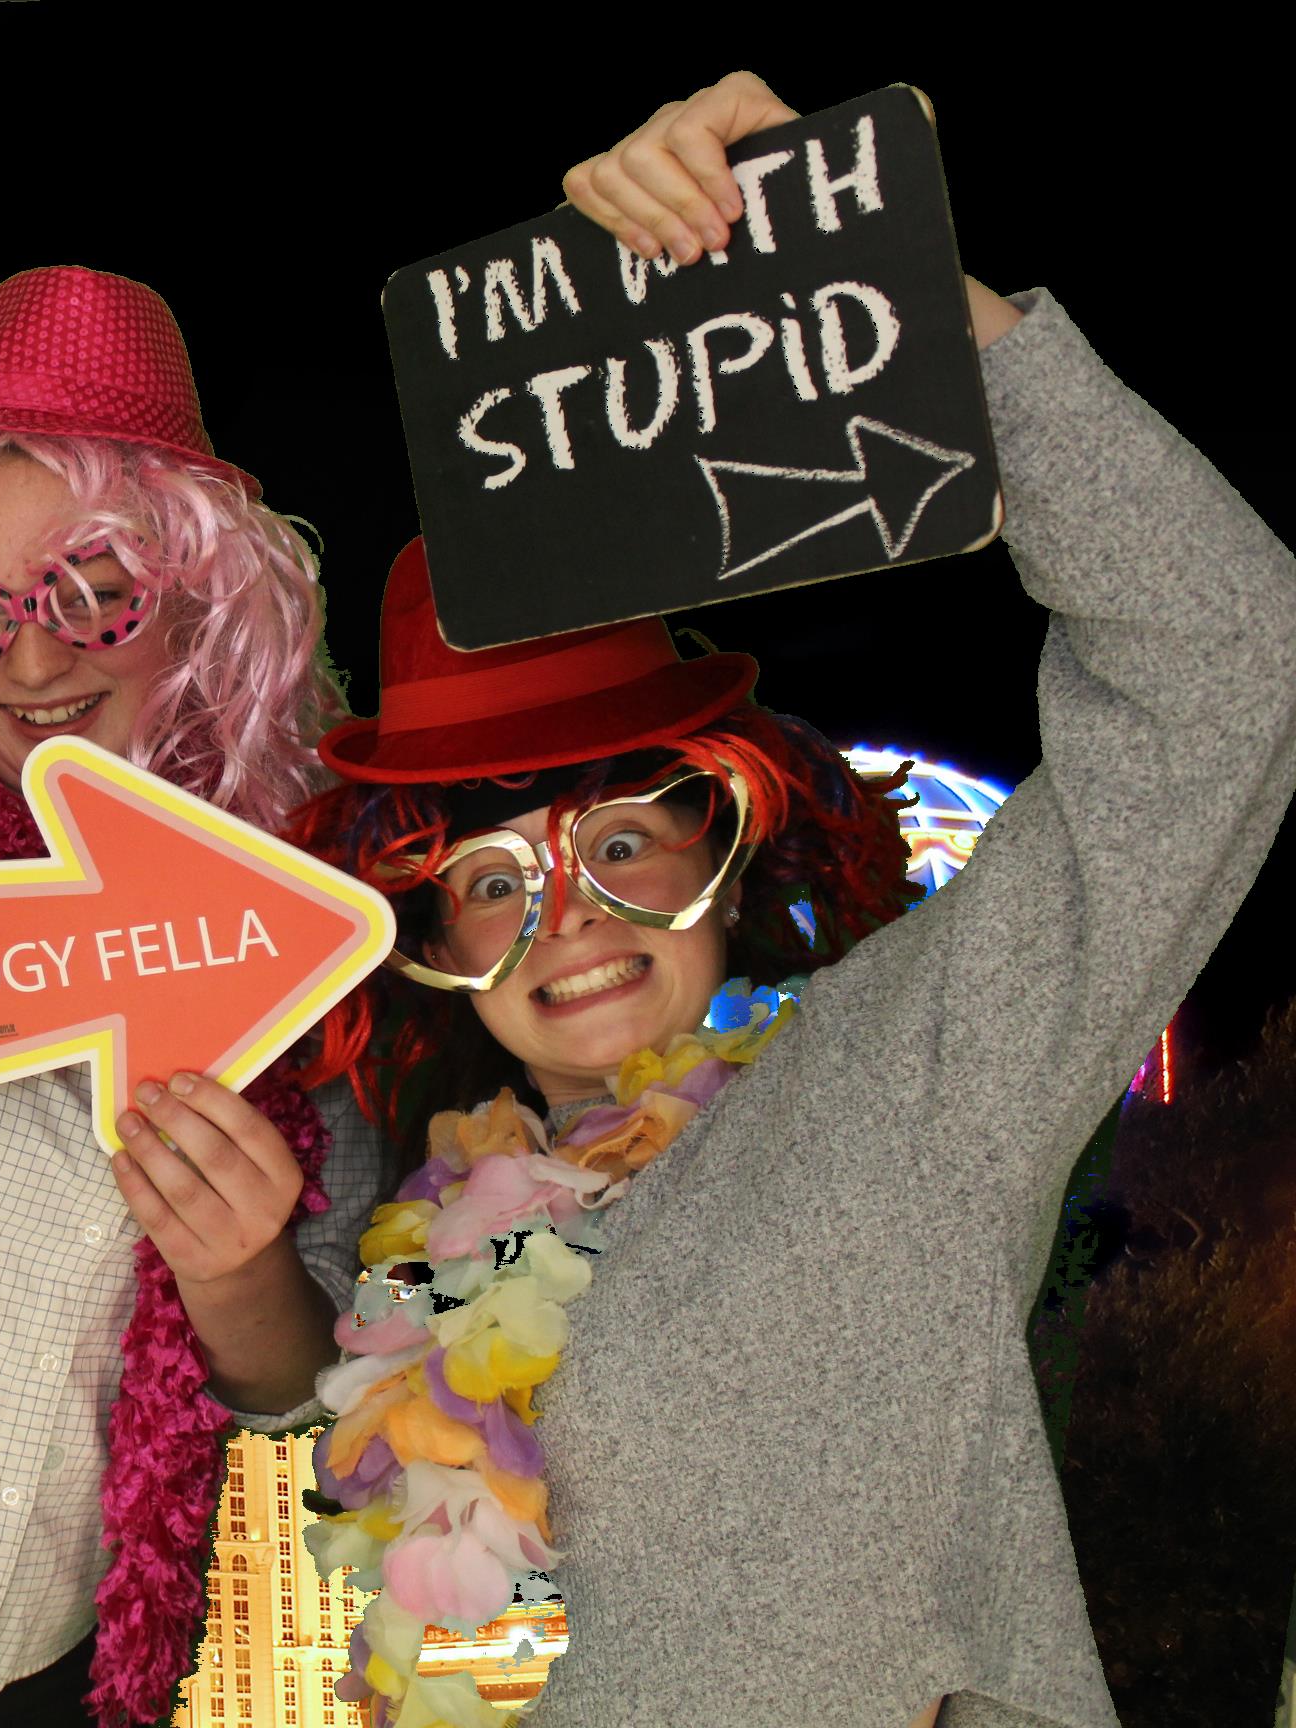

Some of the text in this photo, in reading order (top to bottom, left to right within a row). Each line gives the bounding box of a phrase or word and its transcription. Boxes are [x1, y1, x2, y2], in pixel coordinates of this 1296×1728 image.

[427, 114, 885, 361] I'M TH
[94, 908, 280, 982] FELLA
